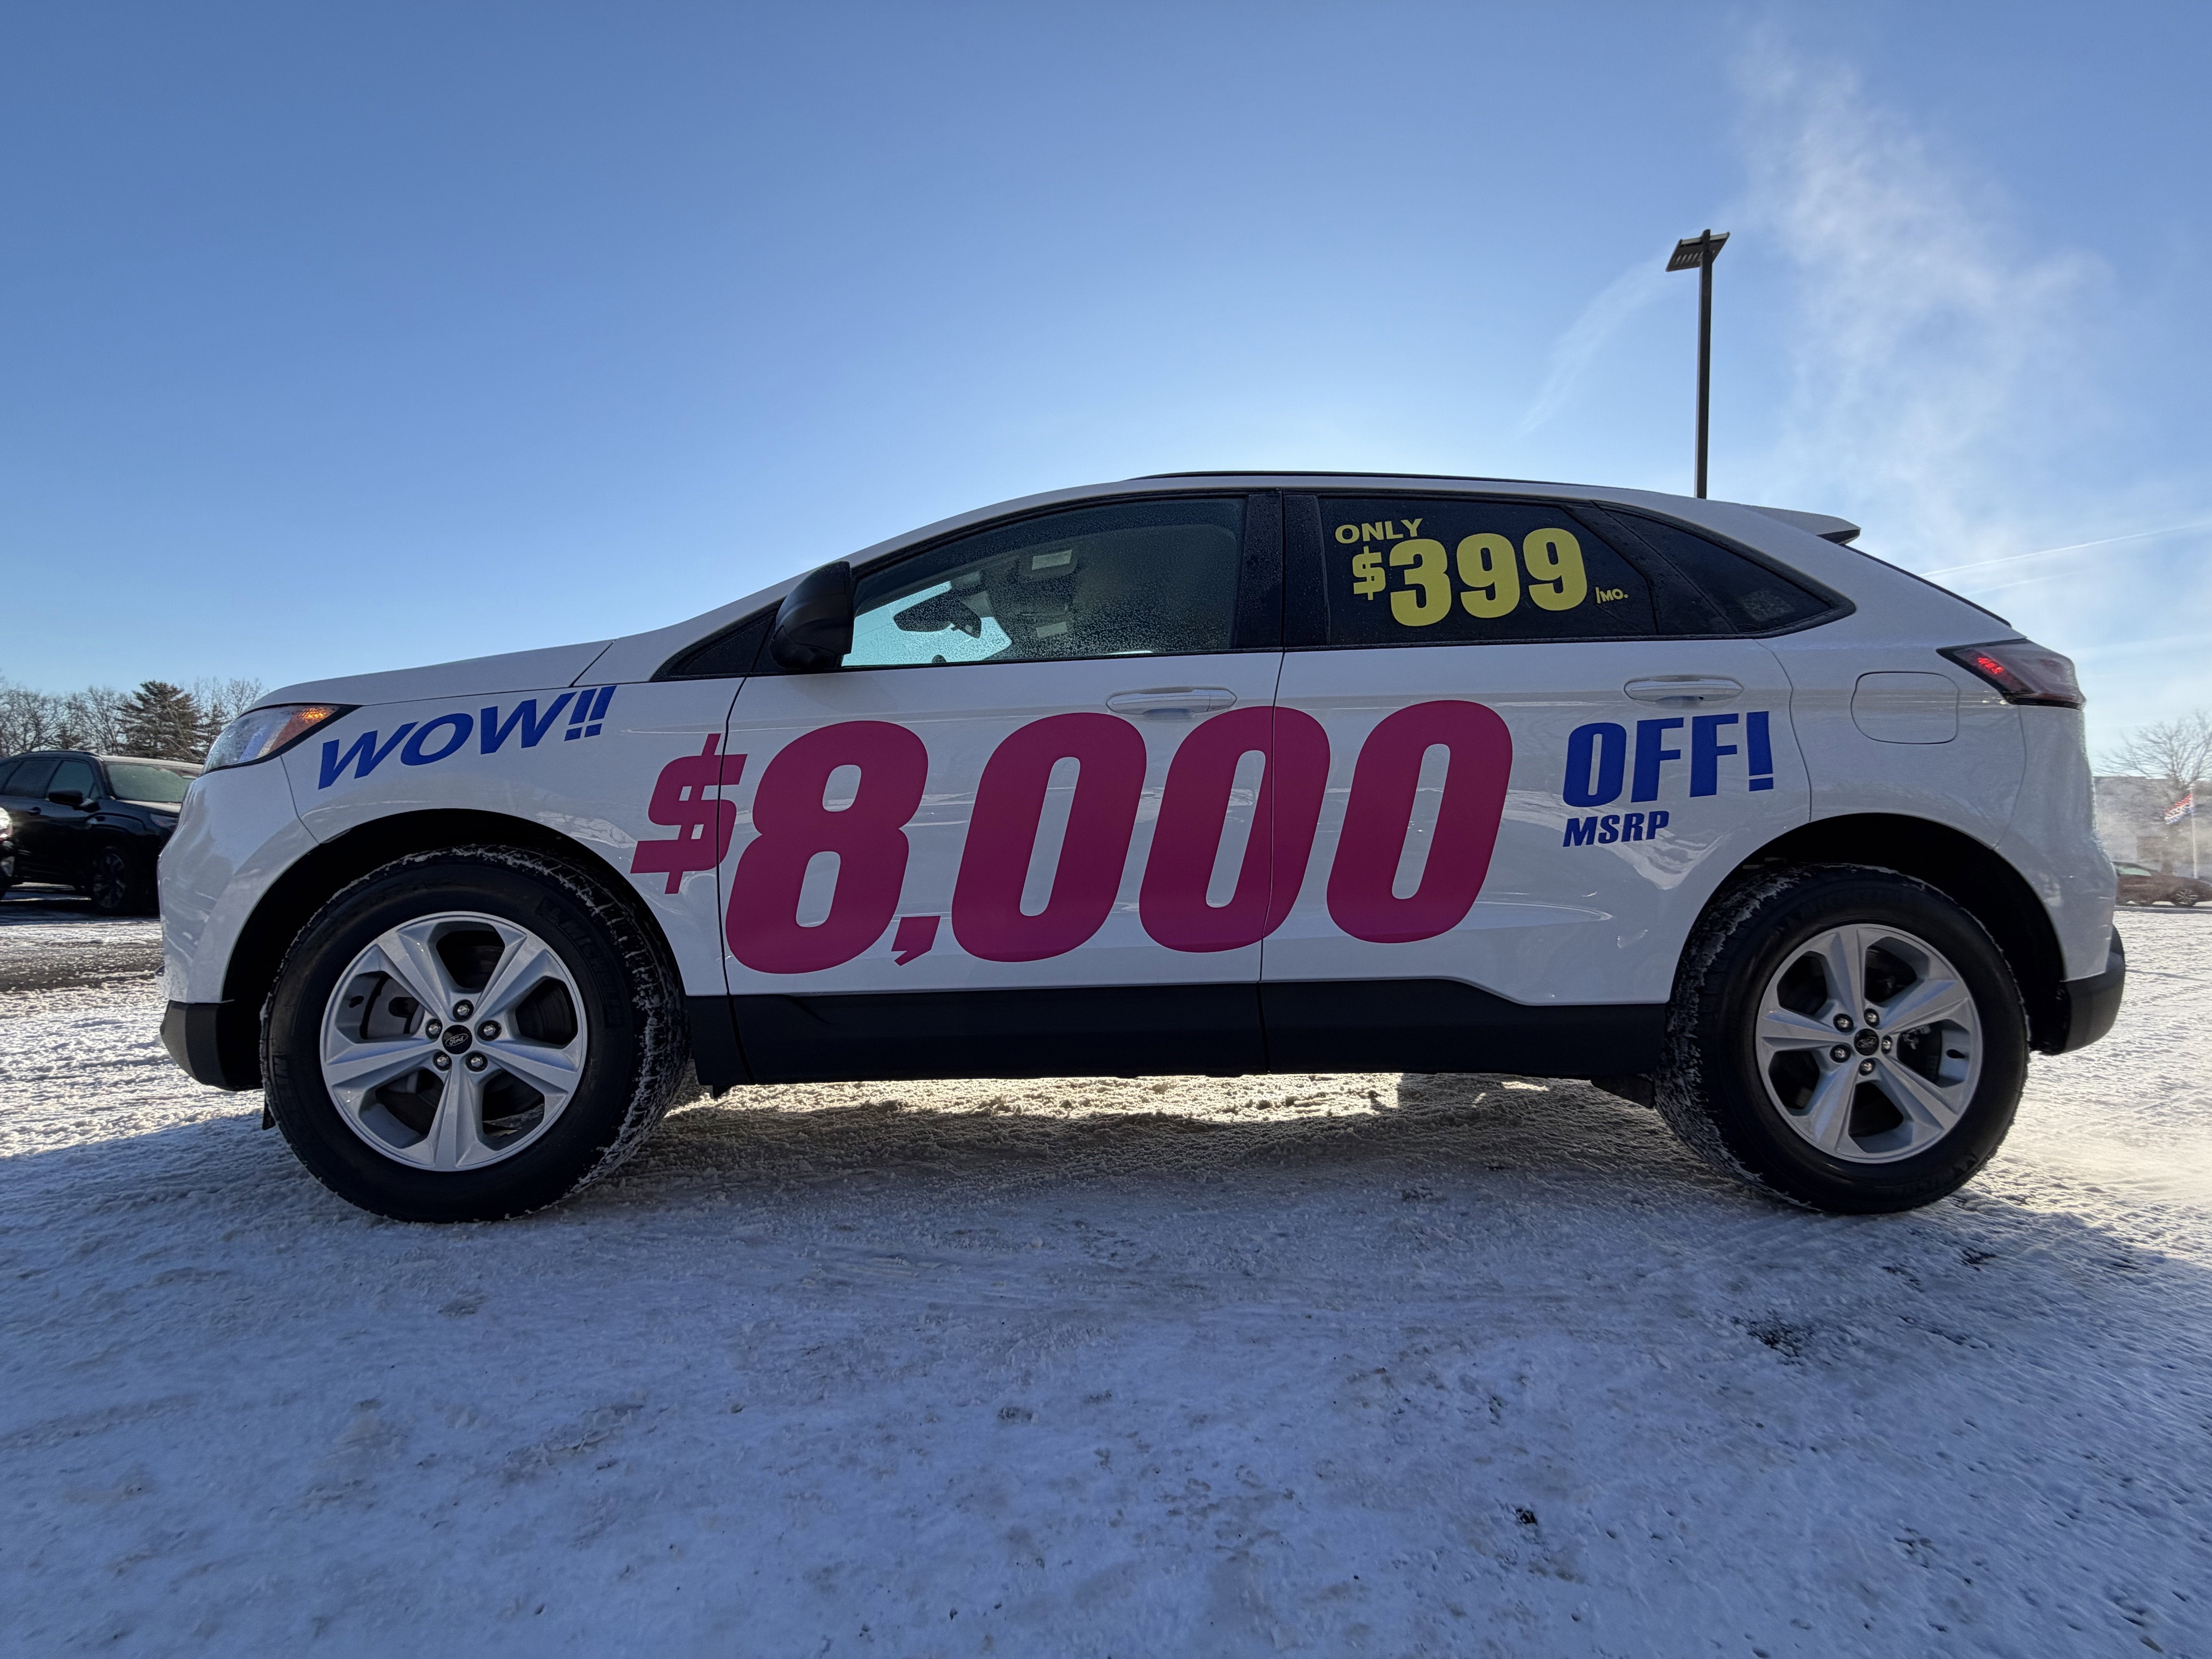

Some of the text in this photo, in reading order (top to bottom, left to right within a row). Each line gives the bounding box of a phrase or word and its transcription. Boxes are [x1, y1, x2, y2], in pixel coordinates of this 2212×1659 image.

[1335, 518, 1422, 544] ONLY
[1352, 528, 1587, 627] $399
[318, 685, 617, 790] WOW!!
[630, 699, 1774, 974] $8,000 OFF!
[1563, 811, 1669, 847] MSRP
[448, 1035, 465, 1046] Ford
